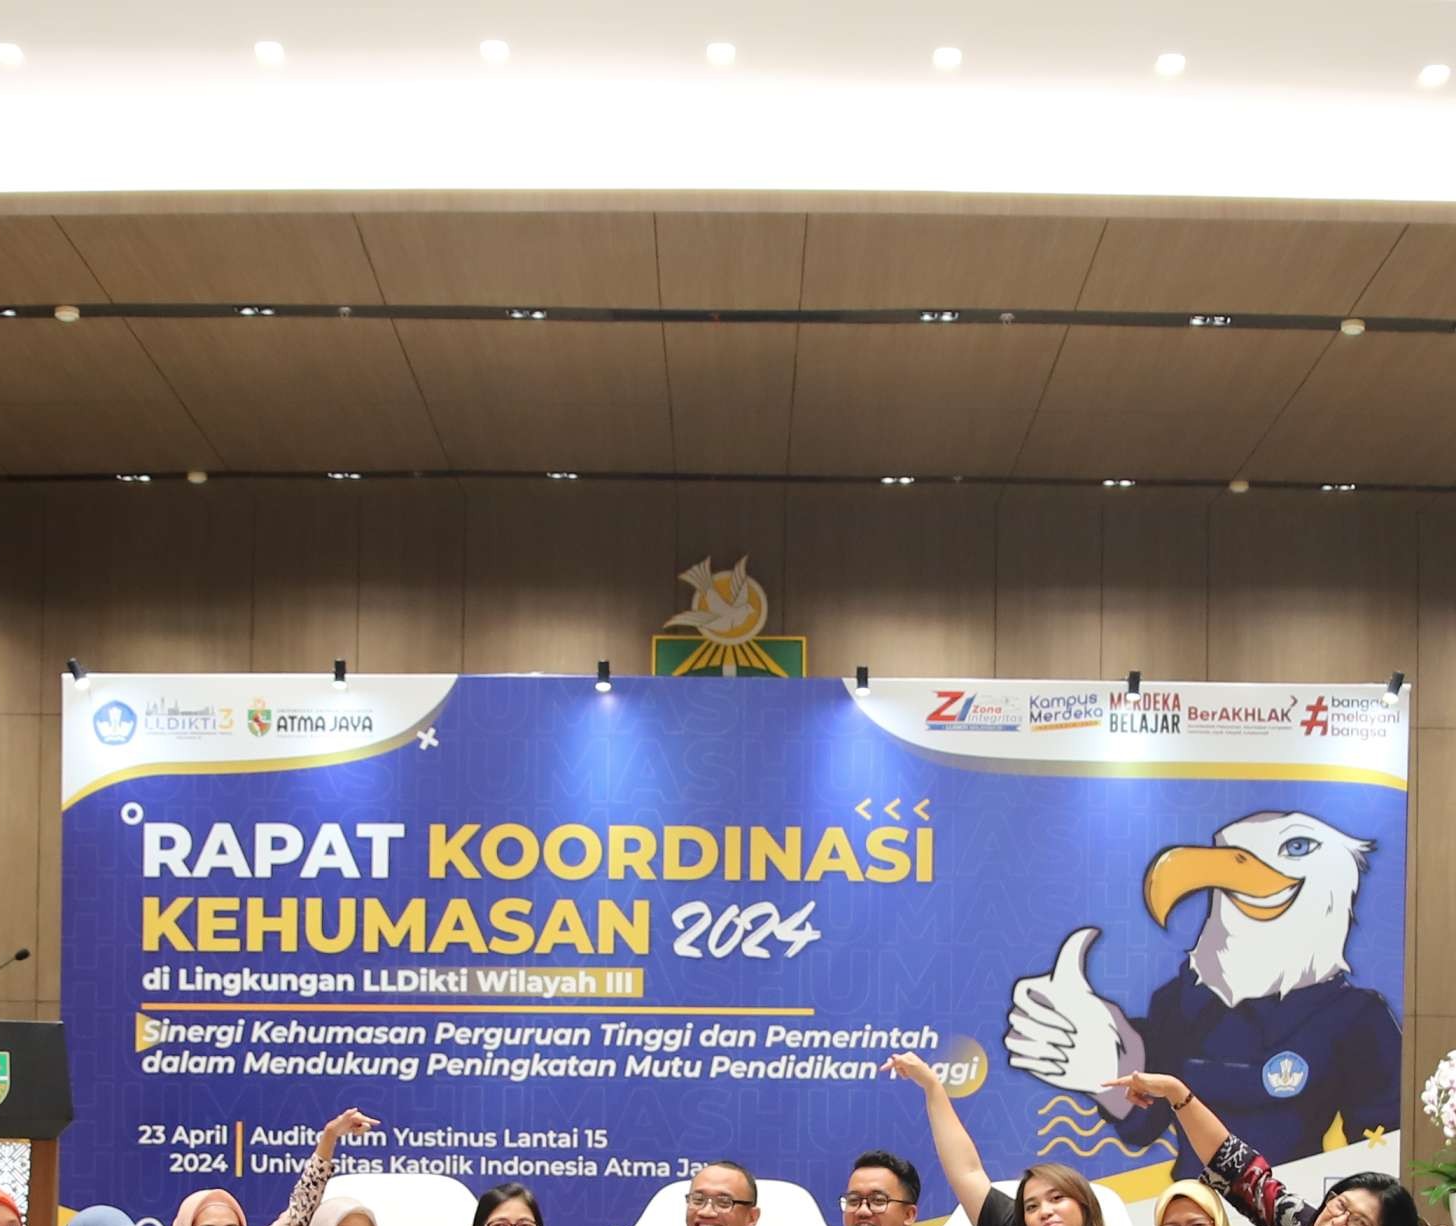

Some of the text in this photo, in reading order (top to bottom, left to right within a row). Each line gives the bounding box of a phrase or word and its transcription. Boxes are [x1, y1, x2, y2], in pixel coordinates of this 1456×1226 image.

[972, 704, 1002, 714] Zona
[1029, 693, 1098, 710] Kampus
[276, 715, 373, 733] ATMA JAYA
[1030, 706, 1103, 723] Merdeka
[1110, 713, 1181, 734] BELAJAR
[1187, 706, 1292, 722] BerAKHLAK
[1331, 711, 1401, 725] melayani
[1331, 725, 1387, 740] bangsa
[143, 822, 934, 883] RAPAT KOORDINASI
[141, 896, 822, 959] KEHUMASAN 2024
[142, 966, 633, 998] di Lingkungan LLDikti Wilayah III
[143, 1019, 939, 1051] Sinergi Kehumasan Perguruan Tinggi dan Pemerintah
[142, 1050, 236, 1074] dalam
[243, 1051, 419, 1081] Mendukung
[426, 1052, 617, 1082] Peningkatan
[624, 1055, 702, 1078] Mutu
[709, 1055, 877, 1080] Pendidikan
[138, 1124, 228, 1149] 23 April
[249, 1125, 608, 1149] Auditium Yustinus Lantai 15
[169, 1153, 228, 1173] 2024
[251, 1152, 384, 1174] Univsitas
[389, 1155, 474, 1175] Katolik
[480, 1156, 598, 1177] Indonesia
[604, 1157, 670, 1177] Atma
